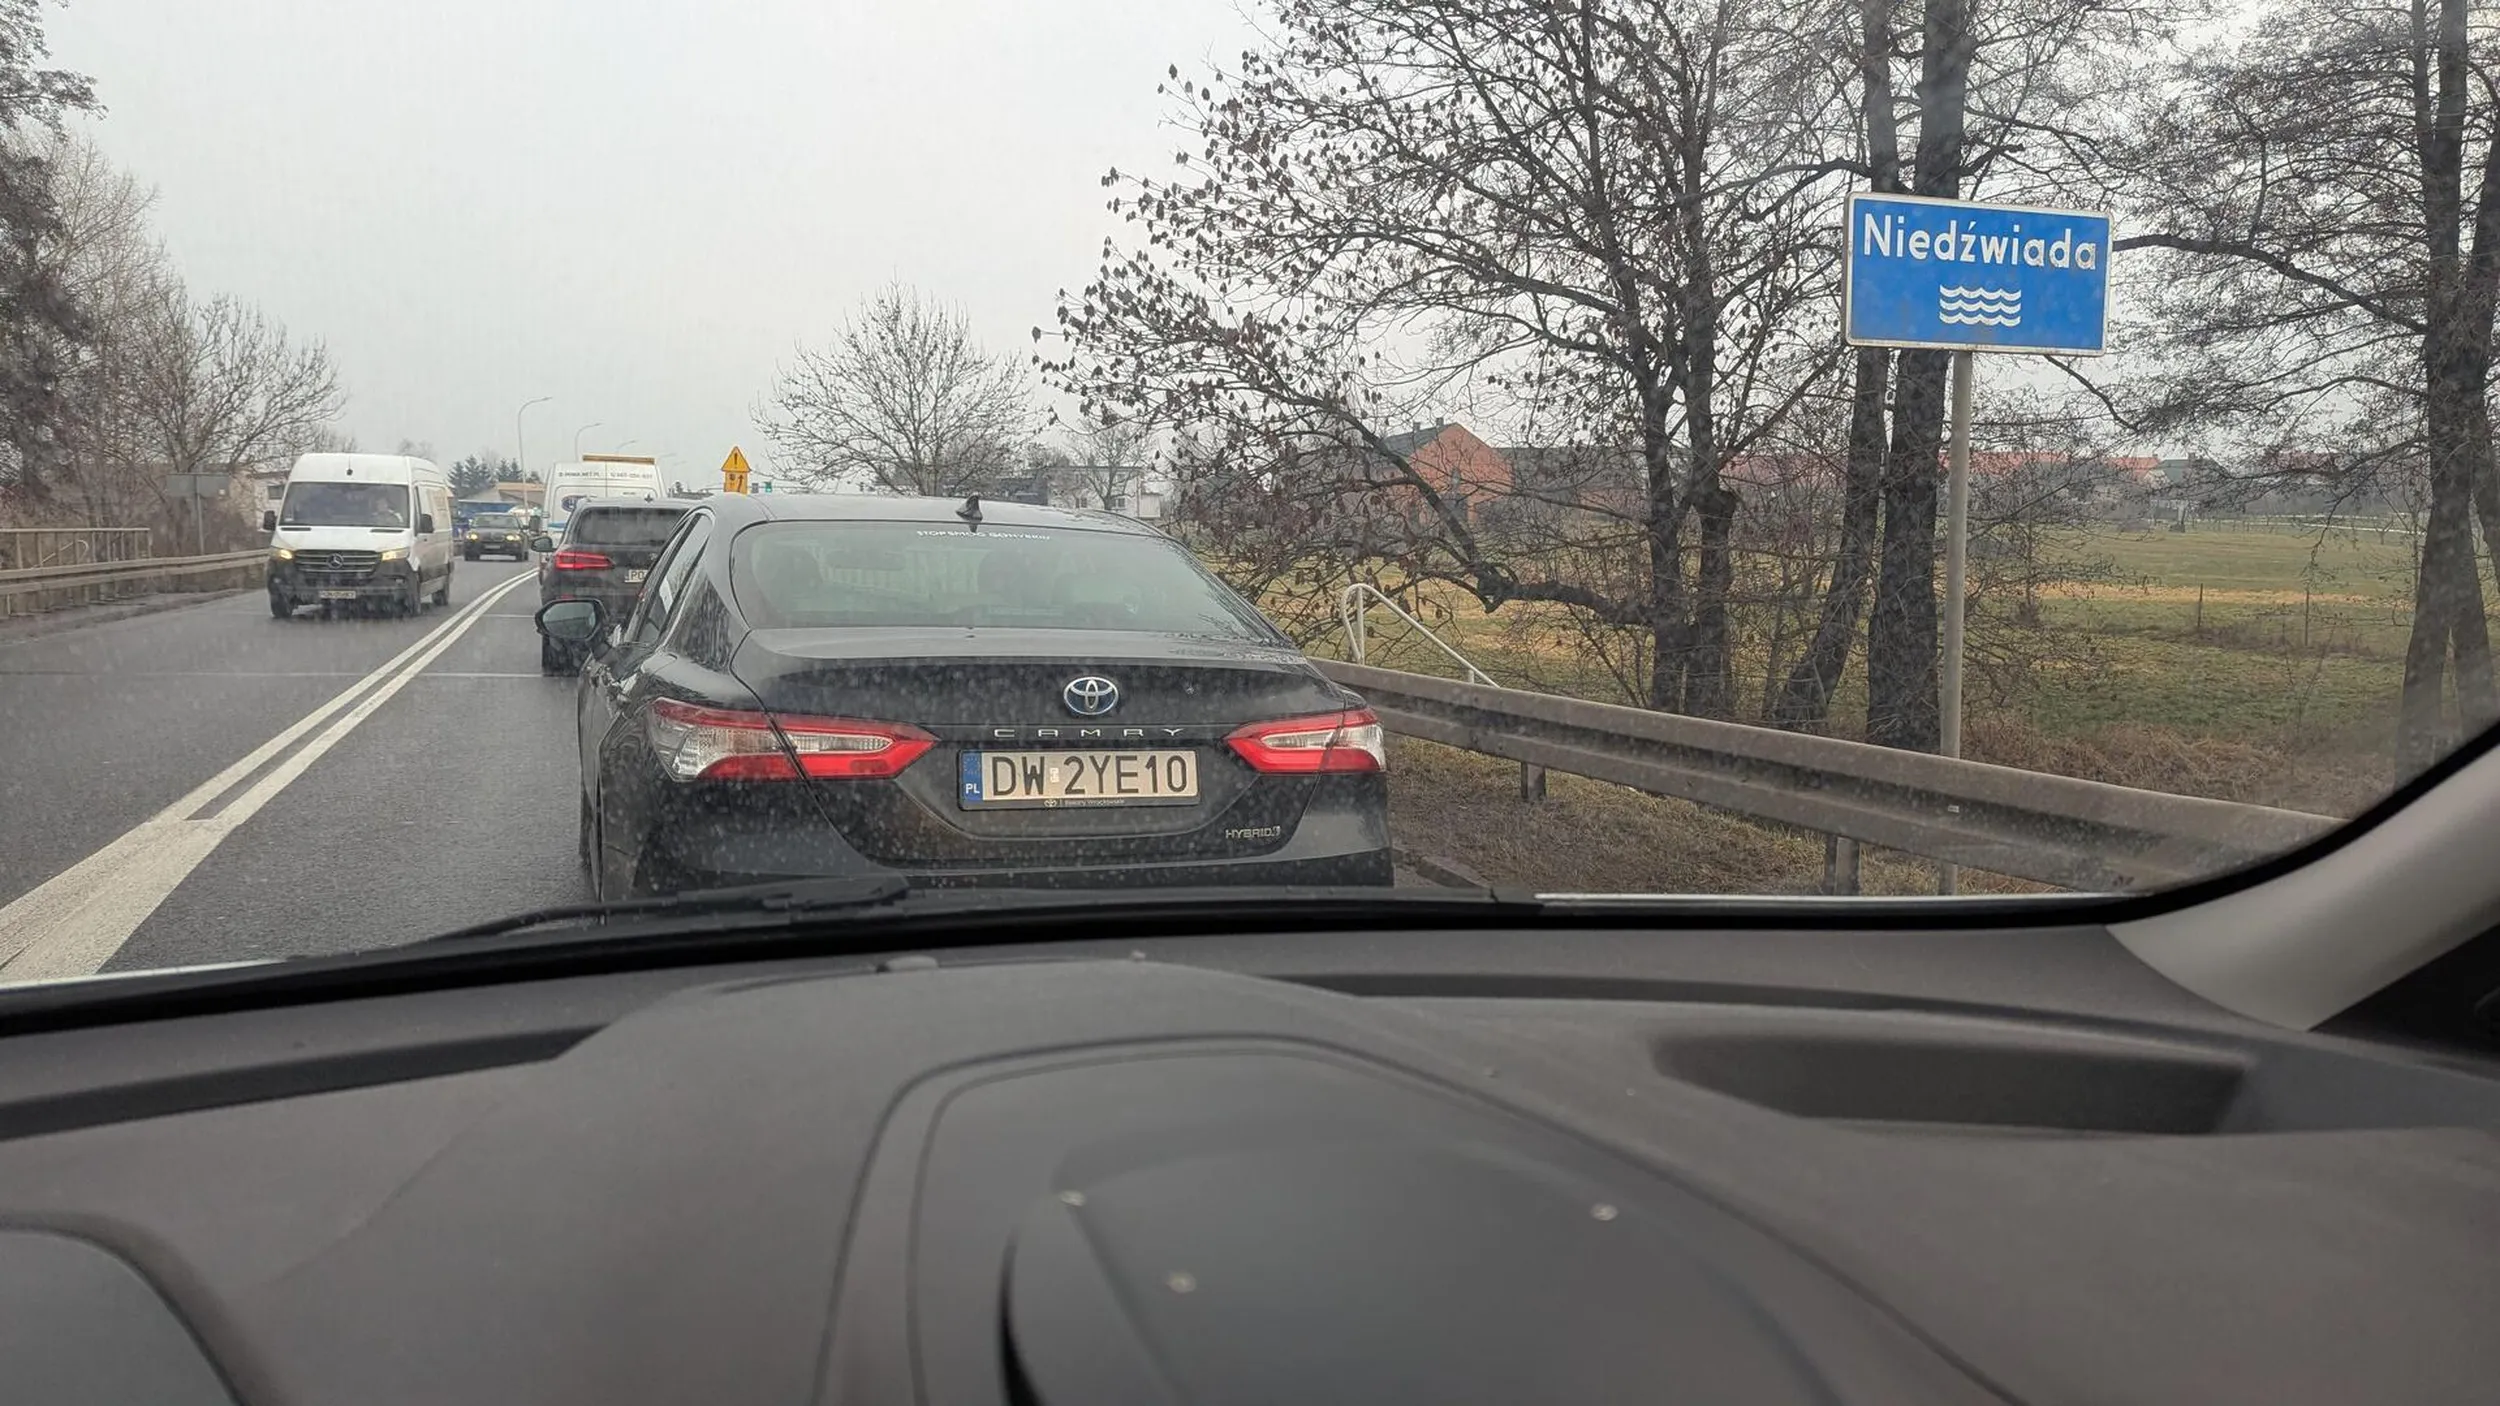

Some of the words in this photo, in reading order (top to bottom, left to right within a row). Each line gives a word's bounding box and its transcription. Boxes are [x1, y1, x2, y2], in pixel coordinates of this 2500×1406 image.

[1863, 213, 2097, 271] Niedźwiada
[994, 728, 1184, 738] CAMRY
[992, 755, 1046, 796] DW
[1064, 754, 1188, 795] 2YE10
[966, 783, 980, 794] PL
[1226, 828, 1272, 839] HYBRID
